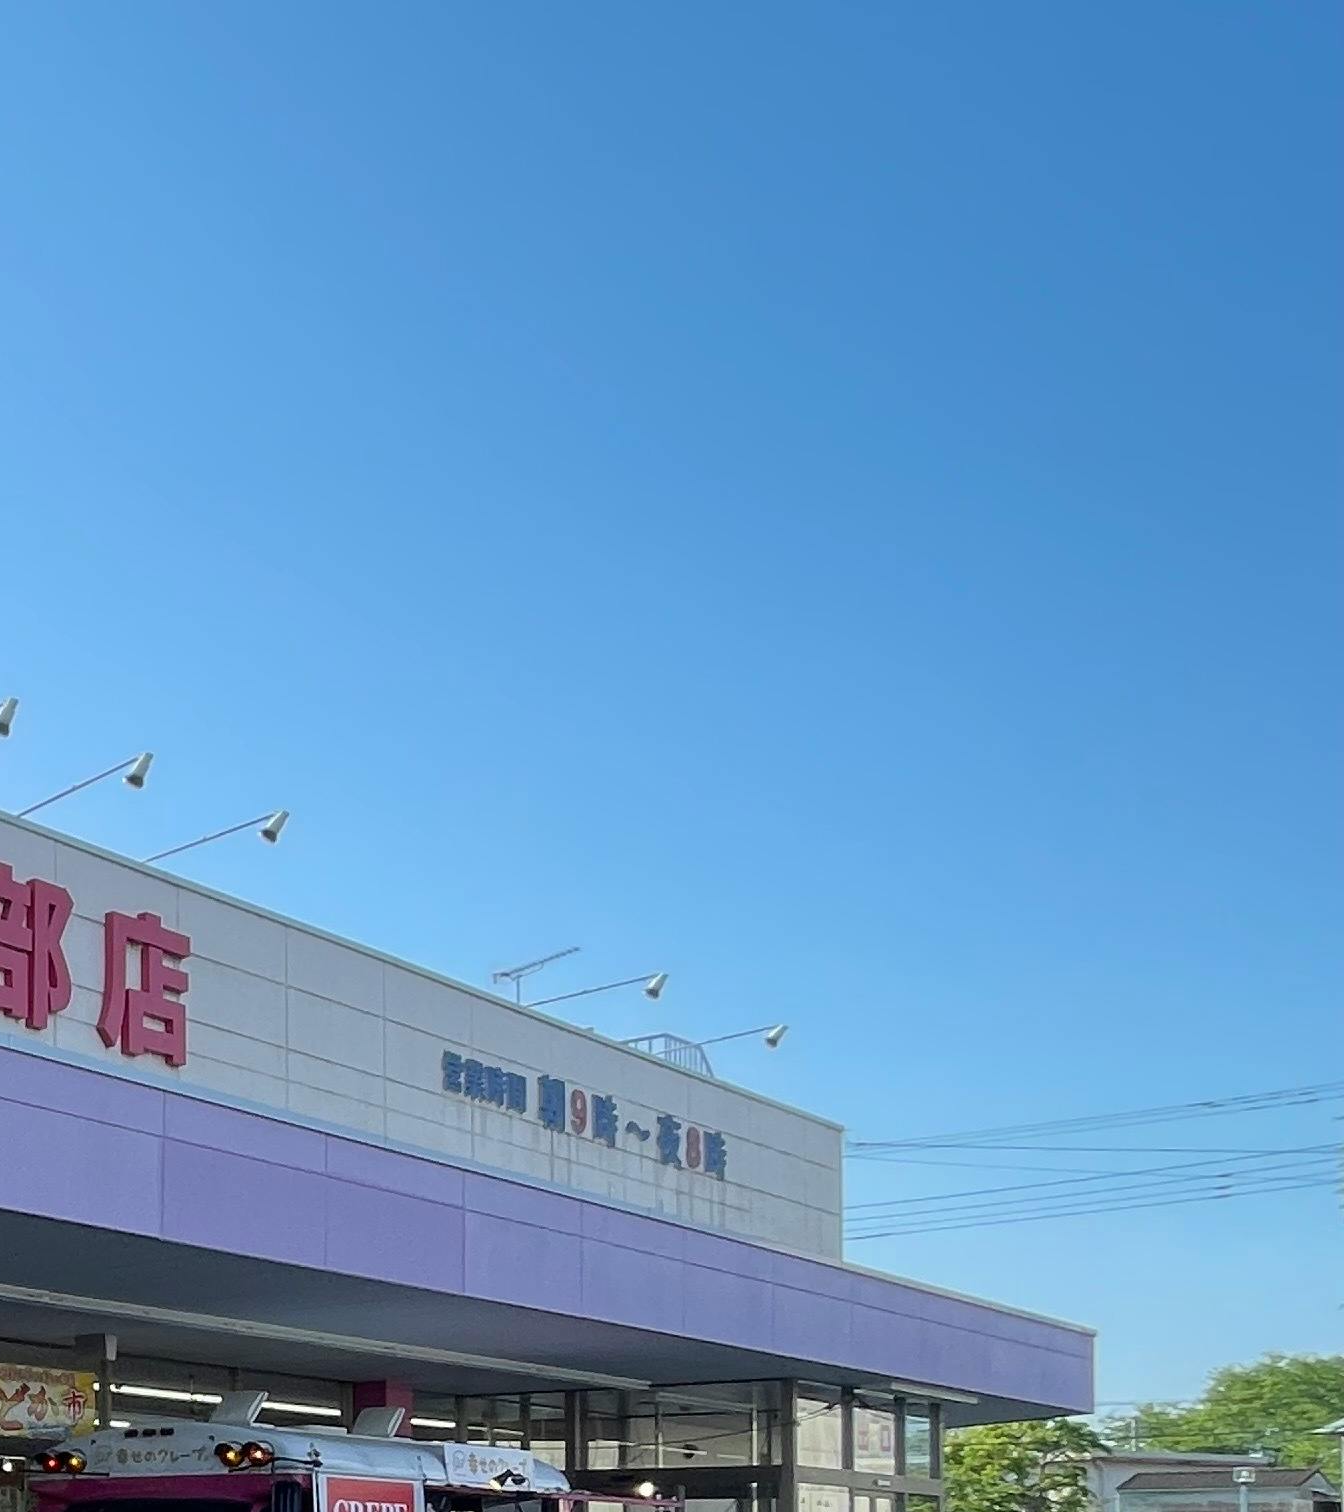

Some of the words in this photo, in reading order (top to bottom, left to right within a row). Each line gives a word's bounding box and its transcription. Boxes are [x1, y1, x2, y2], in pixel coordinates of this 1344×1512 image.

[467, 1451, 528, 1476] 幸せのクープ
